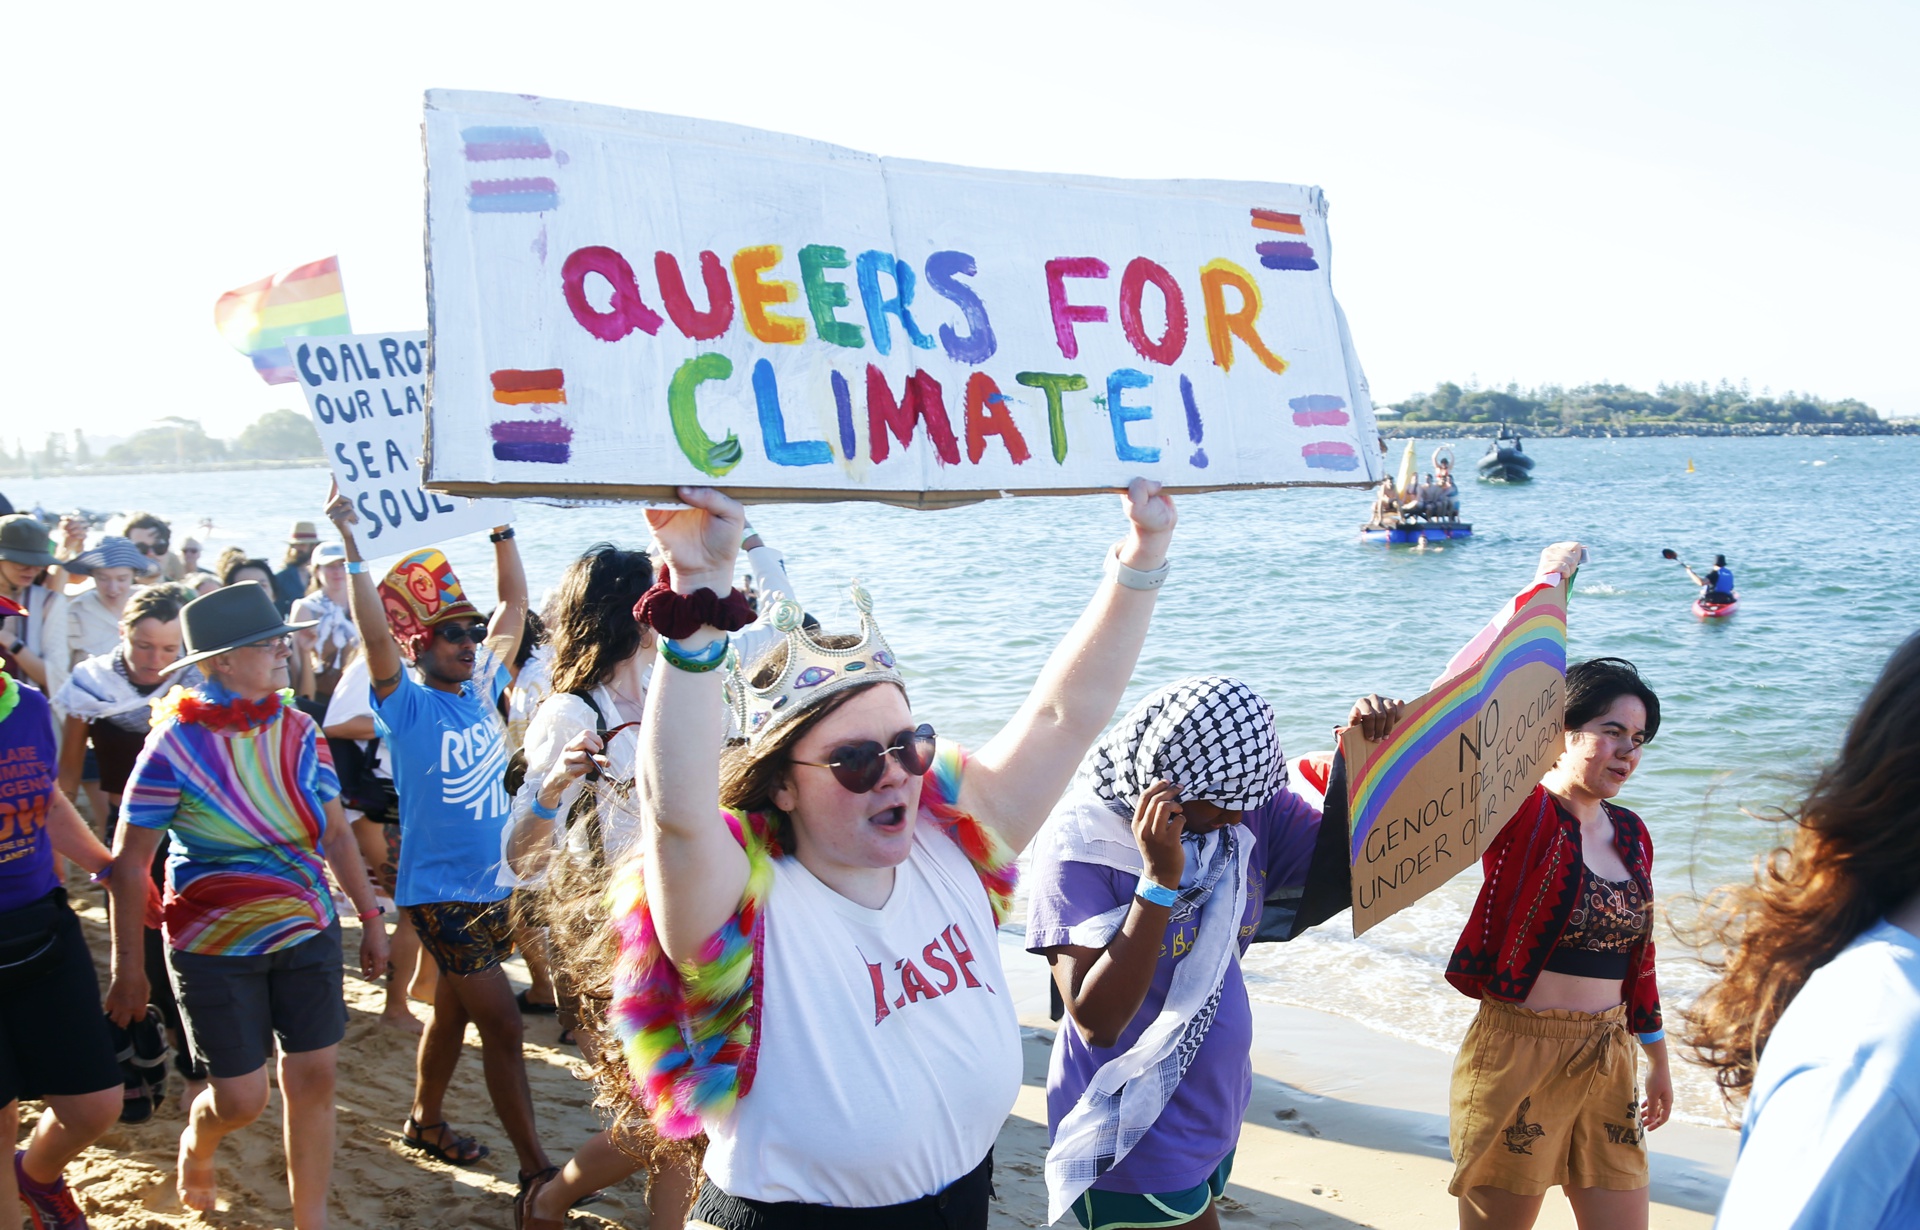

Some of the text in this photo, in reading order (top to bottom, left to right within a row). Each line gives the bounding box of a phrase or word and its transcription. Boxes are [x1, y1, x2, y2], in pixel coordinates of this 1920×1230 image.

[562, 244, 1290, 376] QUEERS FOR
[297, 342, 380, 387] COAL
[315, 384, 425, 424] OUR LA
[667, 352, 1209, 478] CLIMATE!
[334, 438, 409, 482] SEA
[357, 488, 455, 539] SOUL
[0, 746, 38, 764] LARE
[441, 713, 502, 773] RISIN
[1459, 699, 1500, 773] NO
[465, 770, 509, 820] TID
[1365, 680, 1558, 863] GENOCIDE, ECOCIDE
[0, 794, 48, 841] OW
[1359, 706, 1565, 909] UNDER OUR RAINBOW
